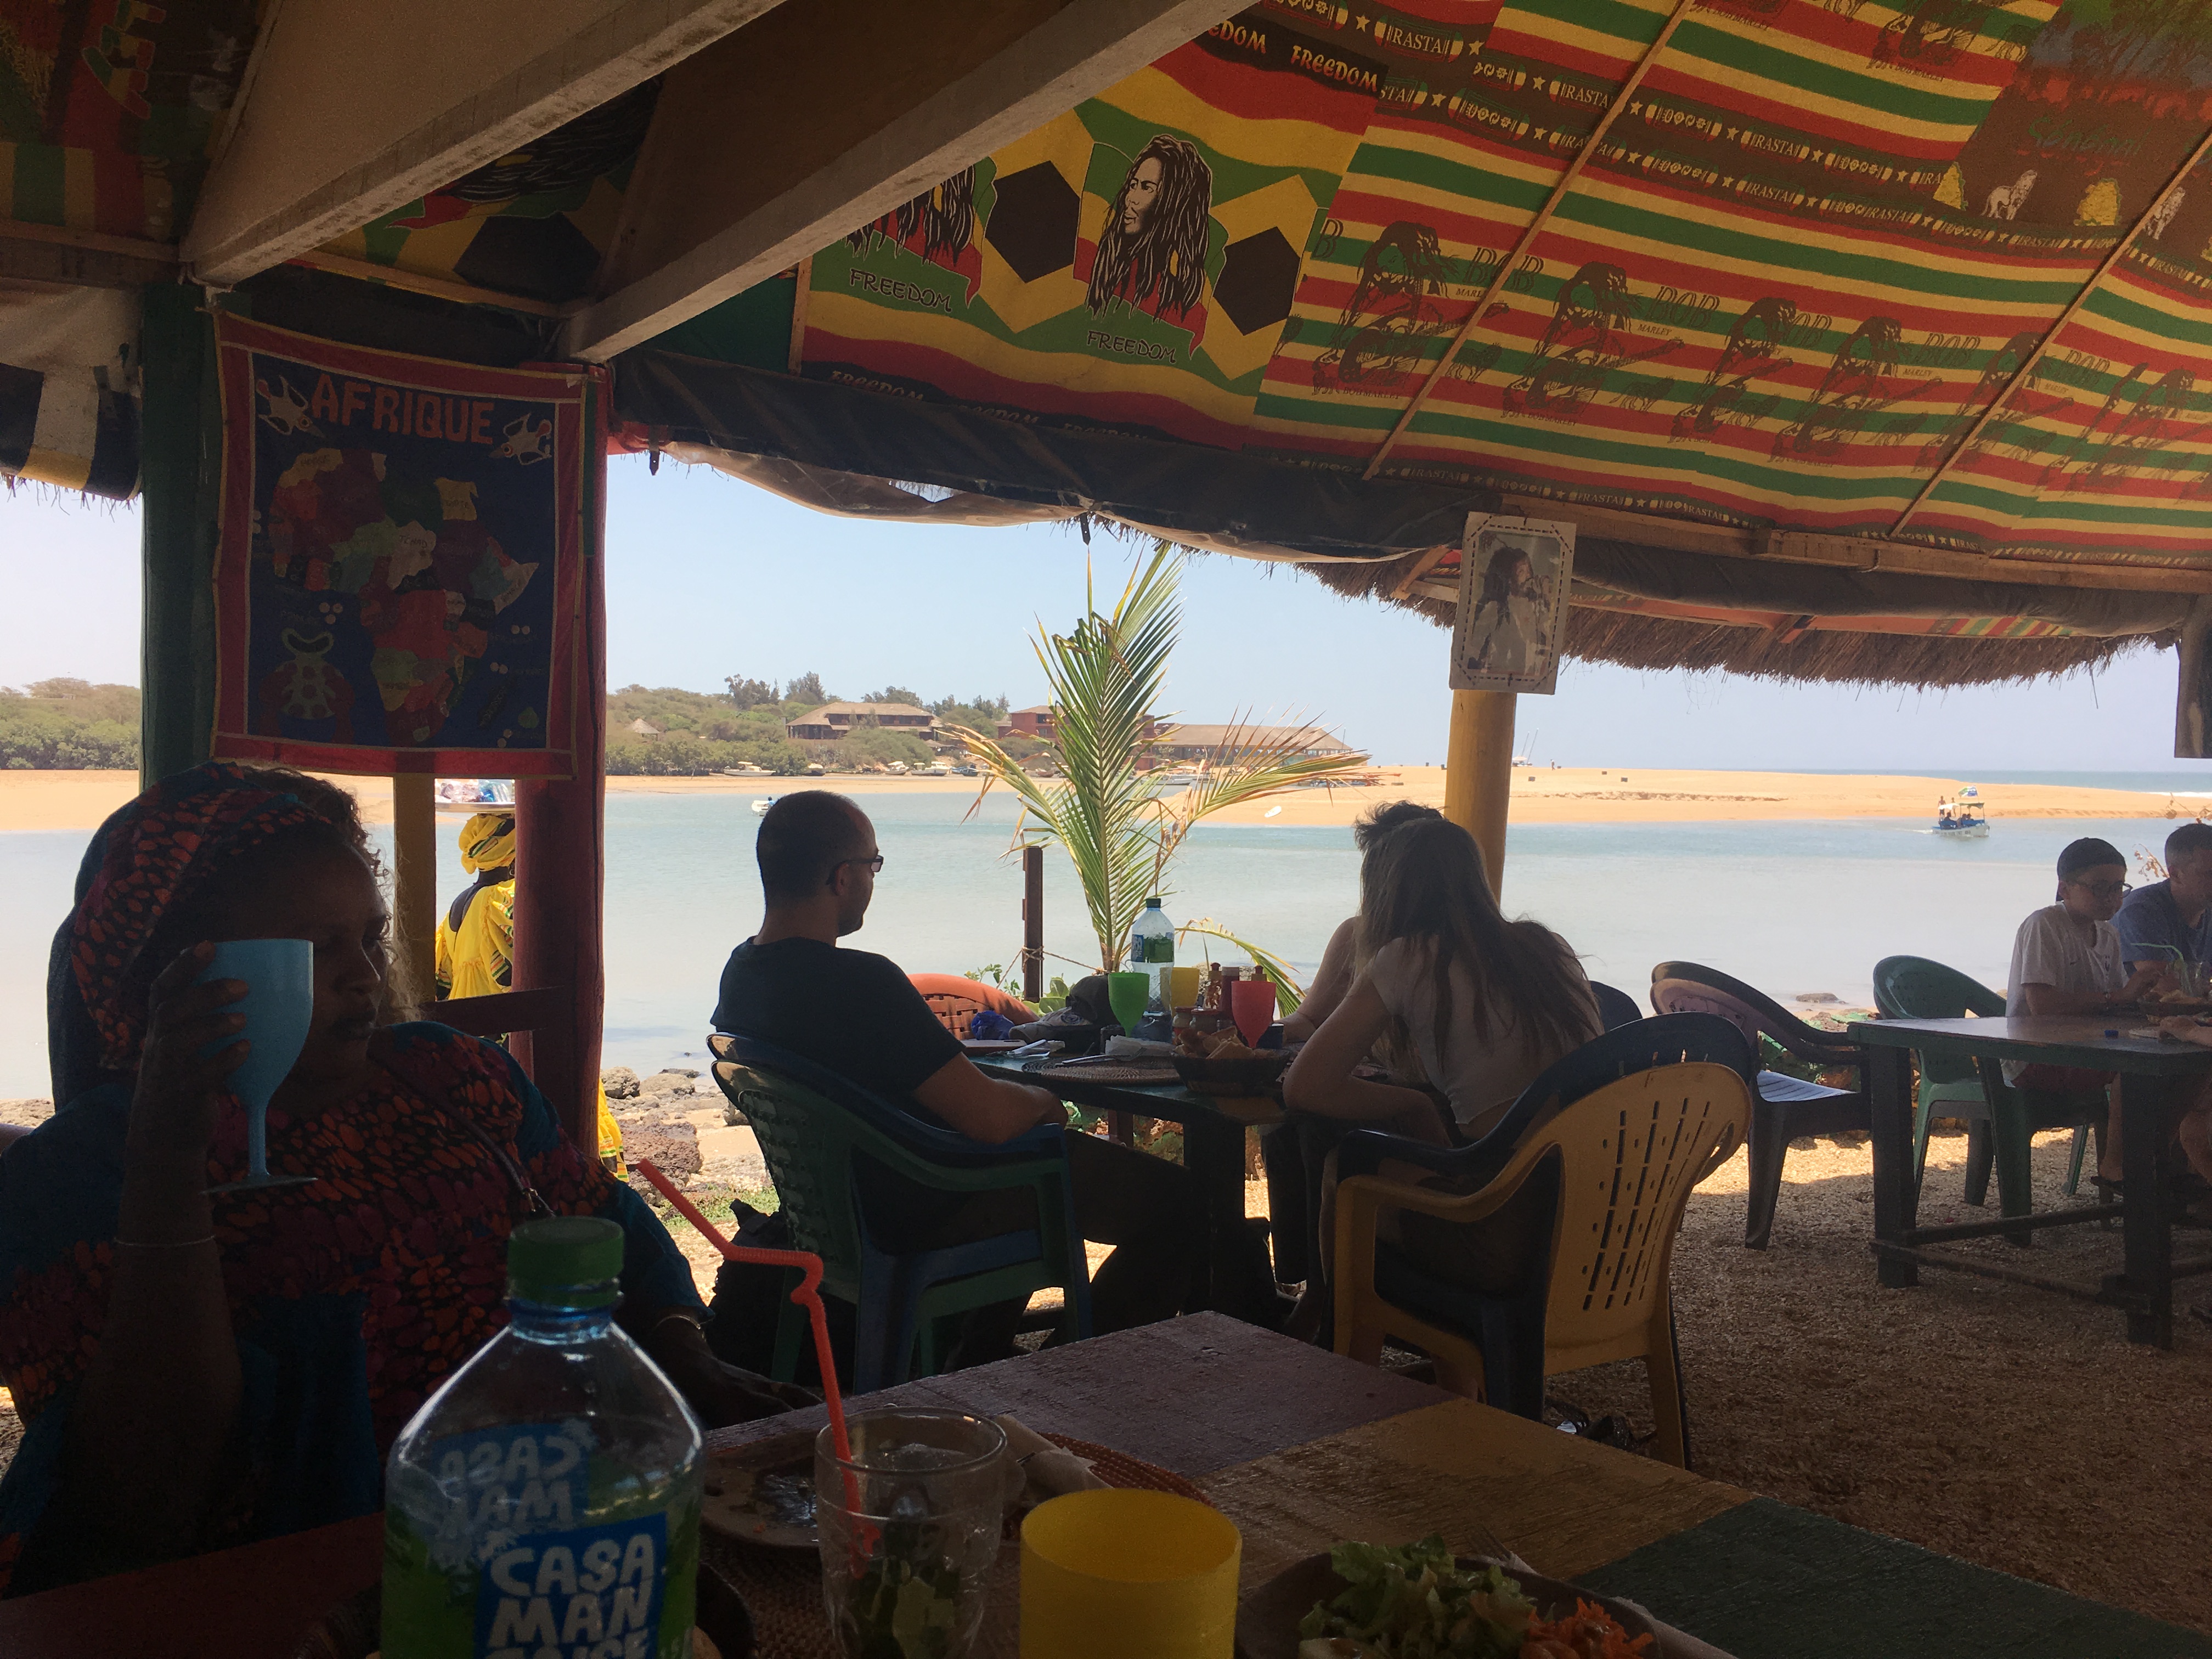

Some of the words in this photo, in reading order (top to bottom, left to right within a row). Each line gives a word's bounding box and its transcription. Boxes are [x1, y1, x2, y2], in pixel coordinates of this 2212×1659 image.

[1392, 27, 1444, 54] RASTA
[1565, 85, 1609, 109] RASTA
[1754, 134, 1795, 157] RASTA
[1750, 184, 1792, 204] RASTA
[1868, 205, 1911, 222] RASTA
[850, 269, 952, 312] FREEDOM
[1646, 286, 1720, 328] BOB
[1087, 330, 1176, 364] FREEDOM
[1637, 324, 1672, 336] MARLEY
[1902, 368, 1934, 378] MARLEY
[312, 373, 494, 445] AFRIQUE
[1416, 467, 1457, 481] RASTA
[1582, 493, 1621, 505] RASTA
[1688, 504, 1722, 520] RASTA
[490, 1533, 654, 1596] CASA
[487, 1578, 653, 1648] MAN
